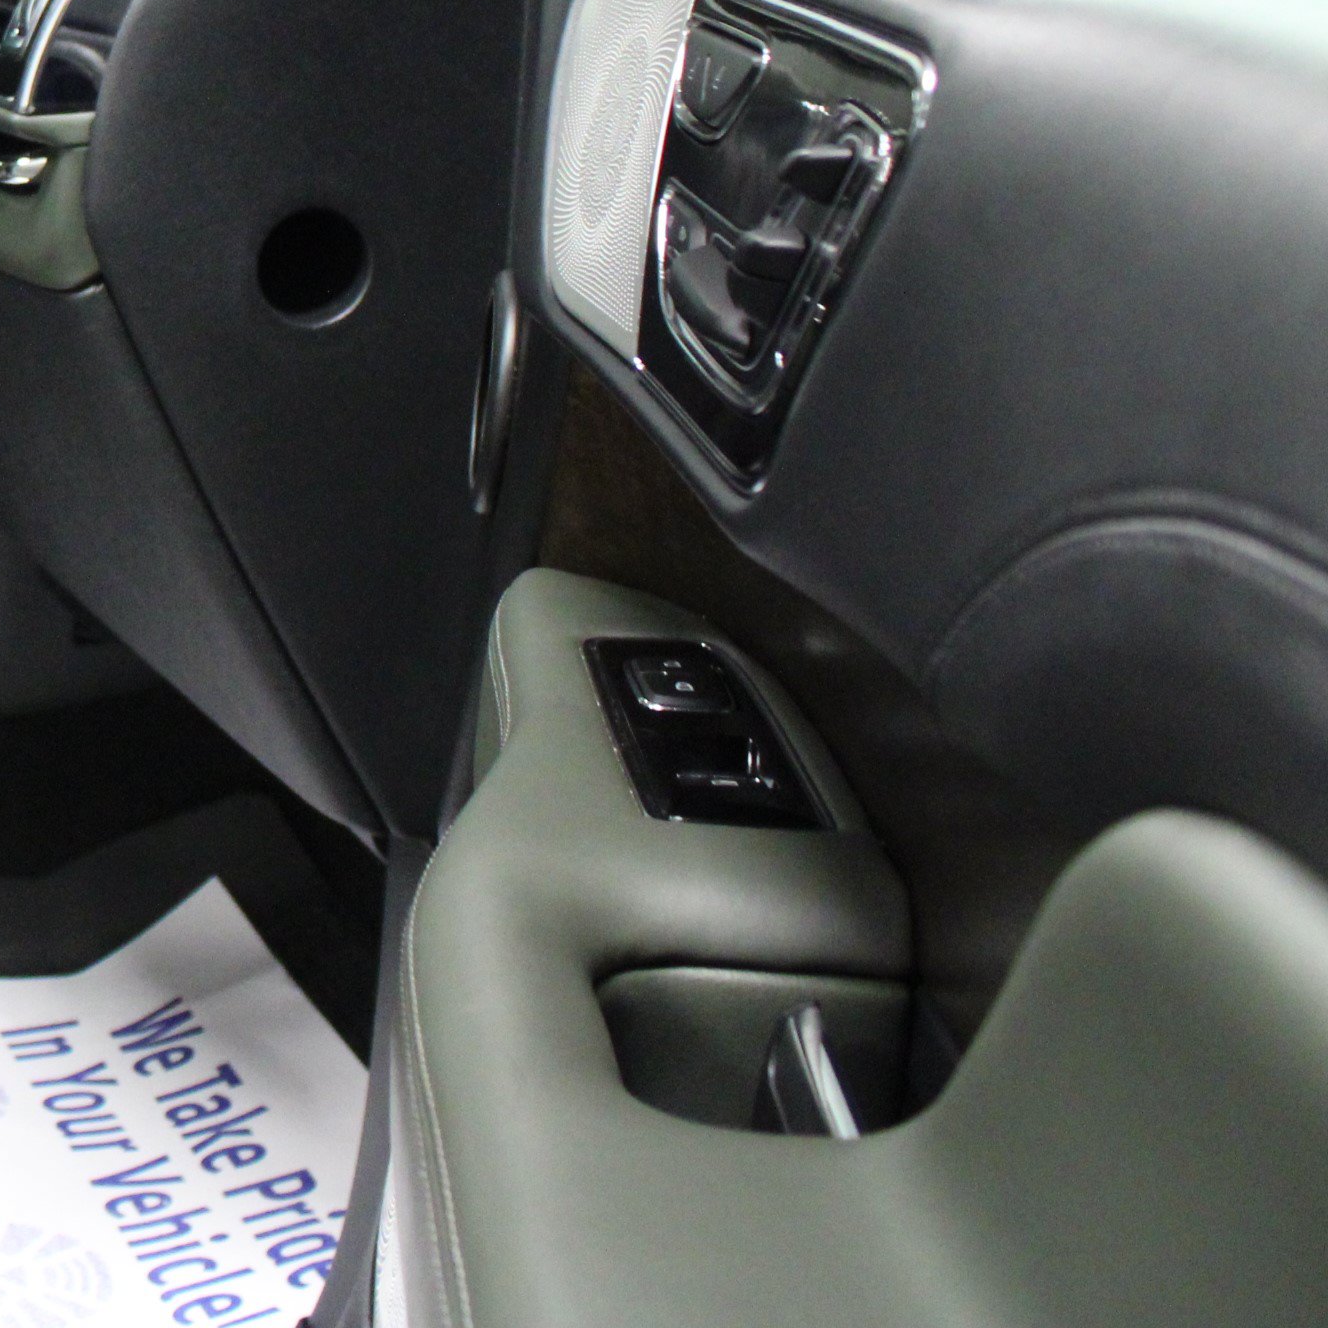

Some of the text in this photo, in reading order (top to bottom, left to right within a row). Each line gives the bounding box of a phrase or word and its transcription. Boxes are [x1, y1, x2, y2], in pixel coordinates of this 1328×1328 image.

[0, 1019, 80, 1062] In
[110, 997, 204, 1077] We
[31, 1062, 138, 1152] Your
[155, 1062, 269, 1173] Take
